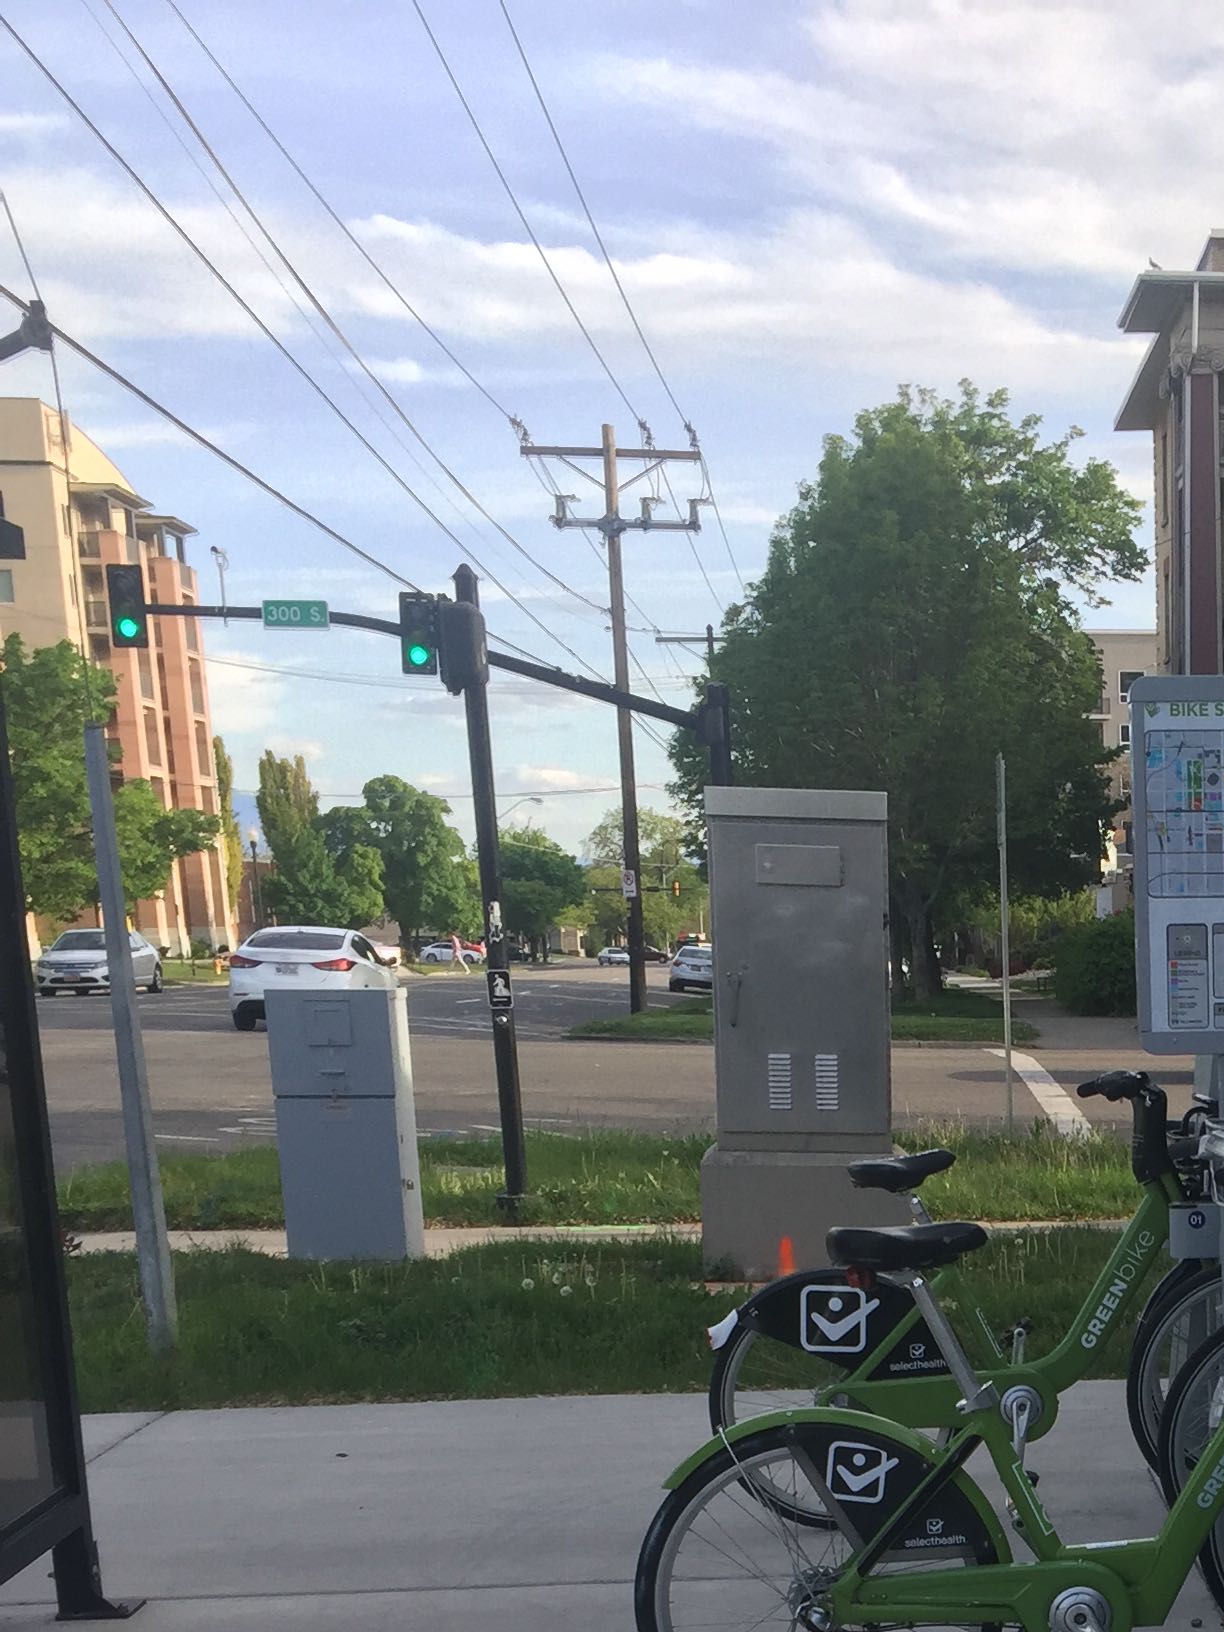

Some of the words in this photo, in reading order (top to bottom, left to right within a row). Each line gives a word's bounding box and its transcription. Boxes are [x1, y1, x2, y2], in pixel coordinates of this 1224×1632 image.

[268, 606, 301, 621] 300
[1170, 702, 1208, 716] BIKE
[1190, 1215, 1202, 1225] 01
[889, 1359, 946, 1371] selecthealth
[904, 1534, 966, 1548] selecthealth
